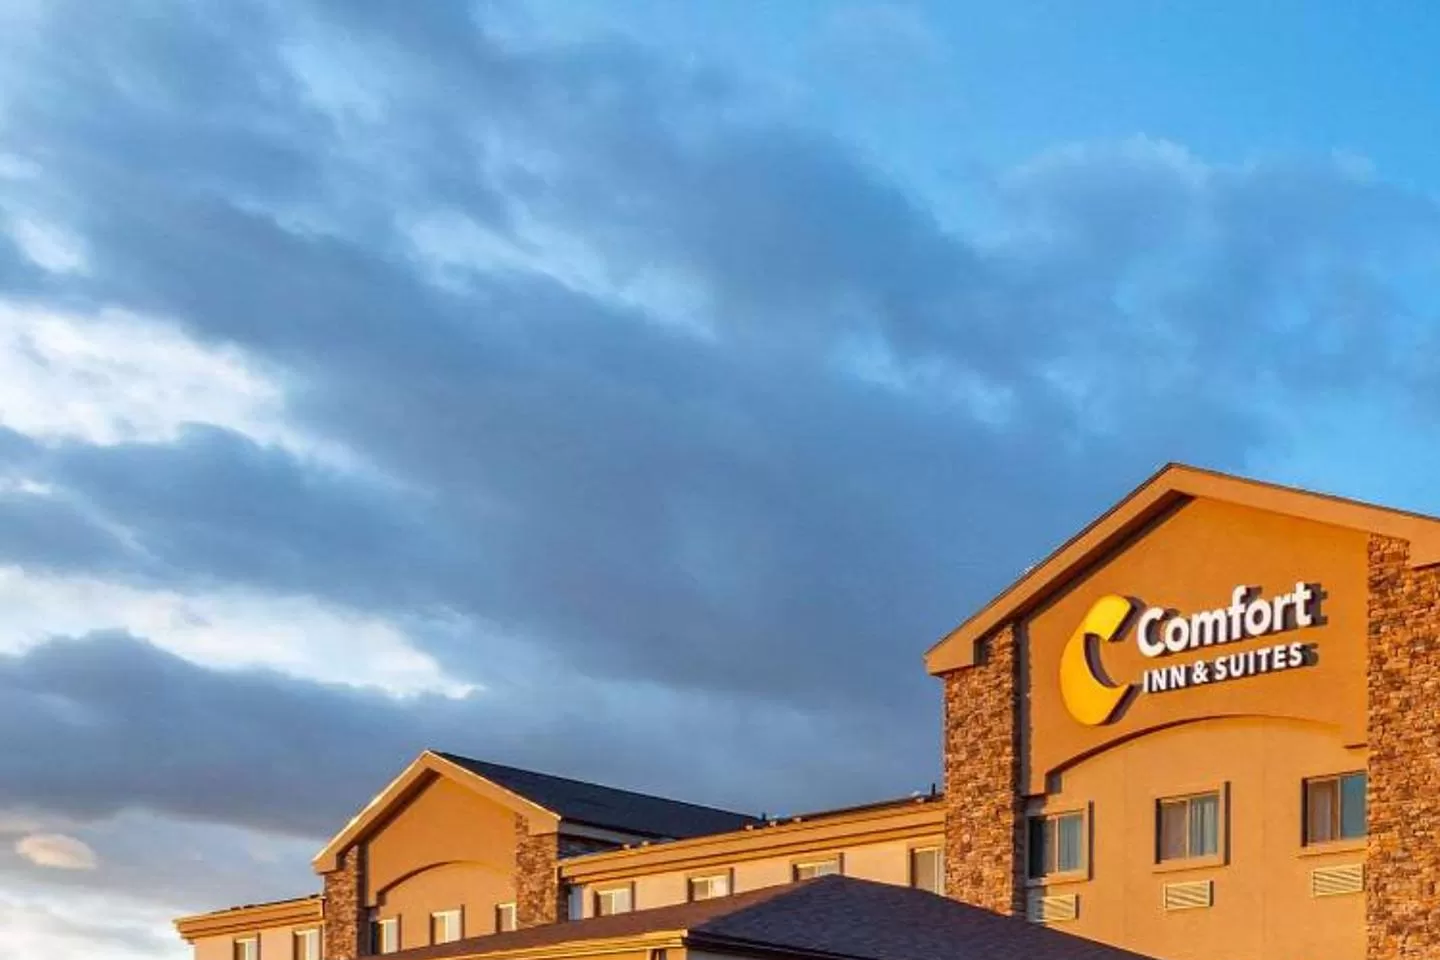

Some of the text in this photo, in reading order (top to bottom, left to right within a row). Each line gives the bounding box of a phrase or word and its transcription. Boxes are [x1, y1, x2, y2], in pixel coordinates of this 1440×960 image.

[1136, 581, 1312, 657] Comfort
[1143, 642, 1302, 692] INN & SUITES
